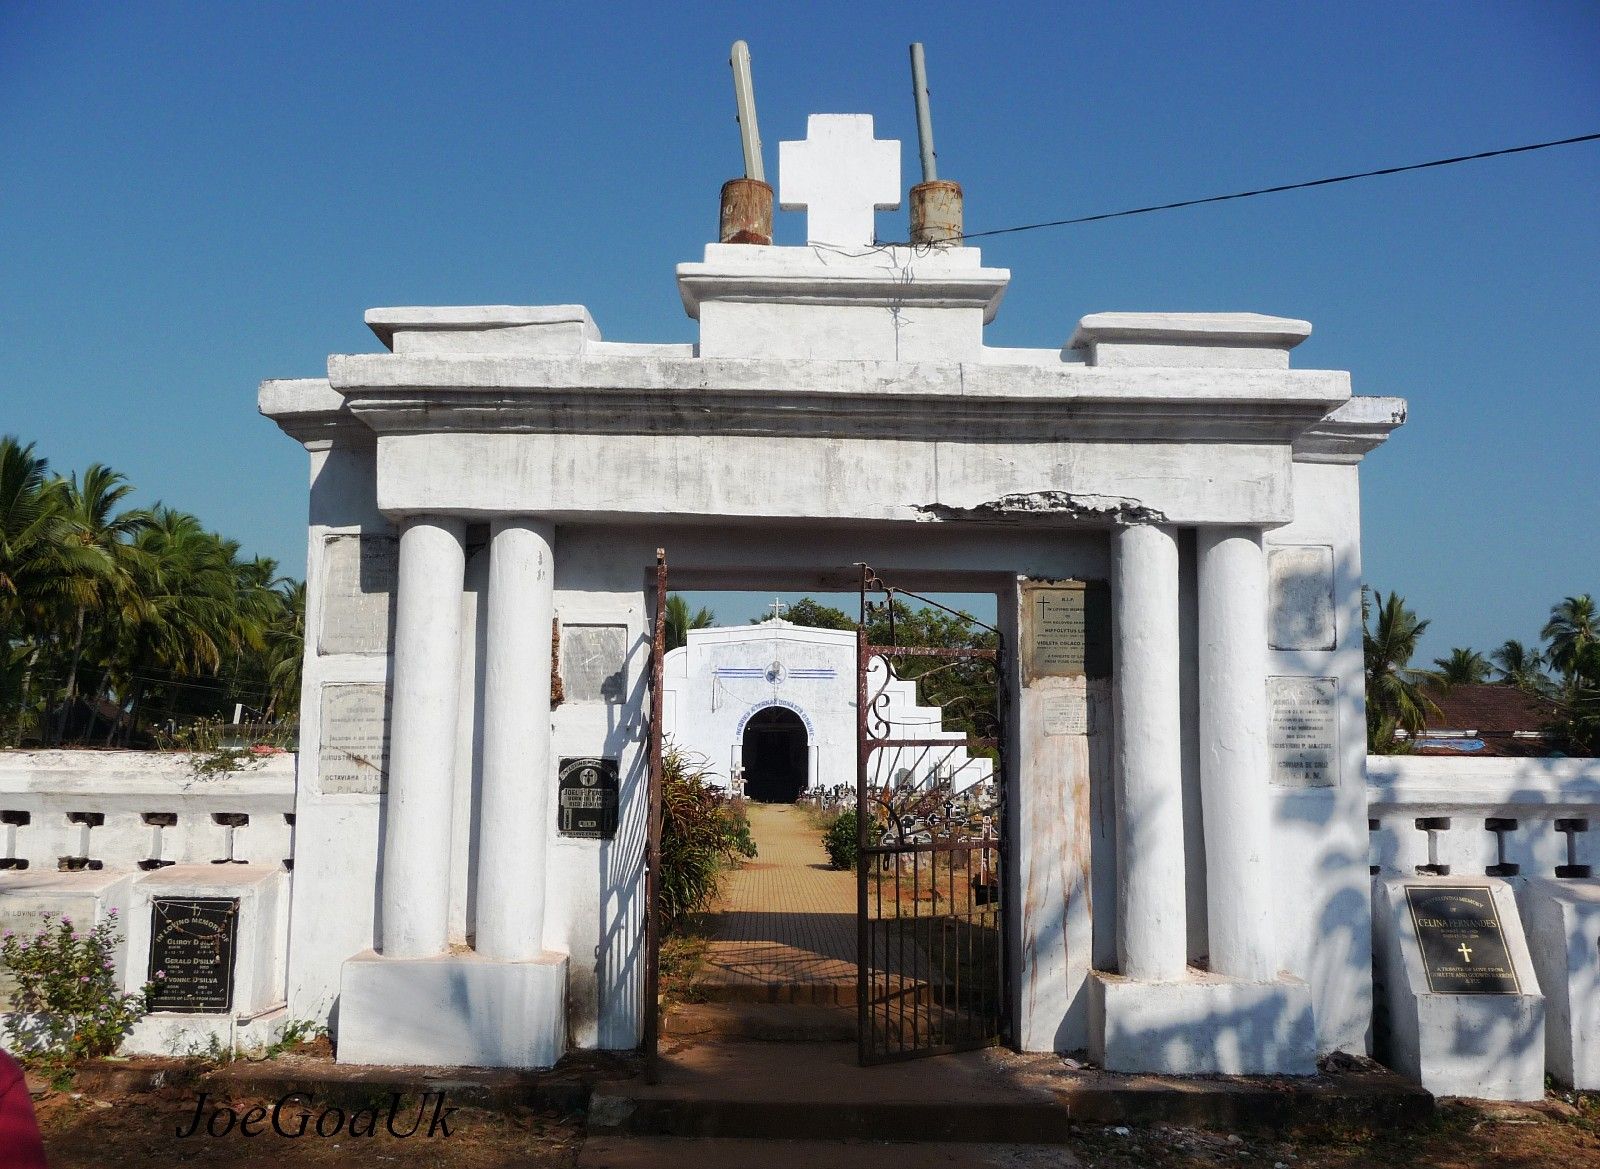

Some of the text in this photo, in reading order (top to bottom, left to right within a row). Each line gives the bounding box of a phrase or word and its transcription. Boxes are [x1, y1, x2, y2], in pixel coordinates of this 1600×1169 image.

[1460, 897, 1484, 908] MEMORY
[1418, 918, 1496, 928] CELINA FERNANDES
[156, 933, 164, 942] IN
[163, 918, 190, 934] LOVING
